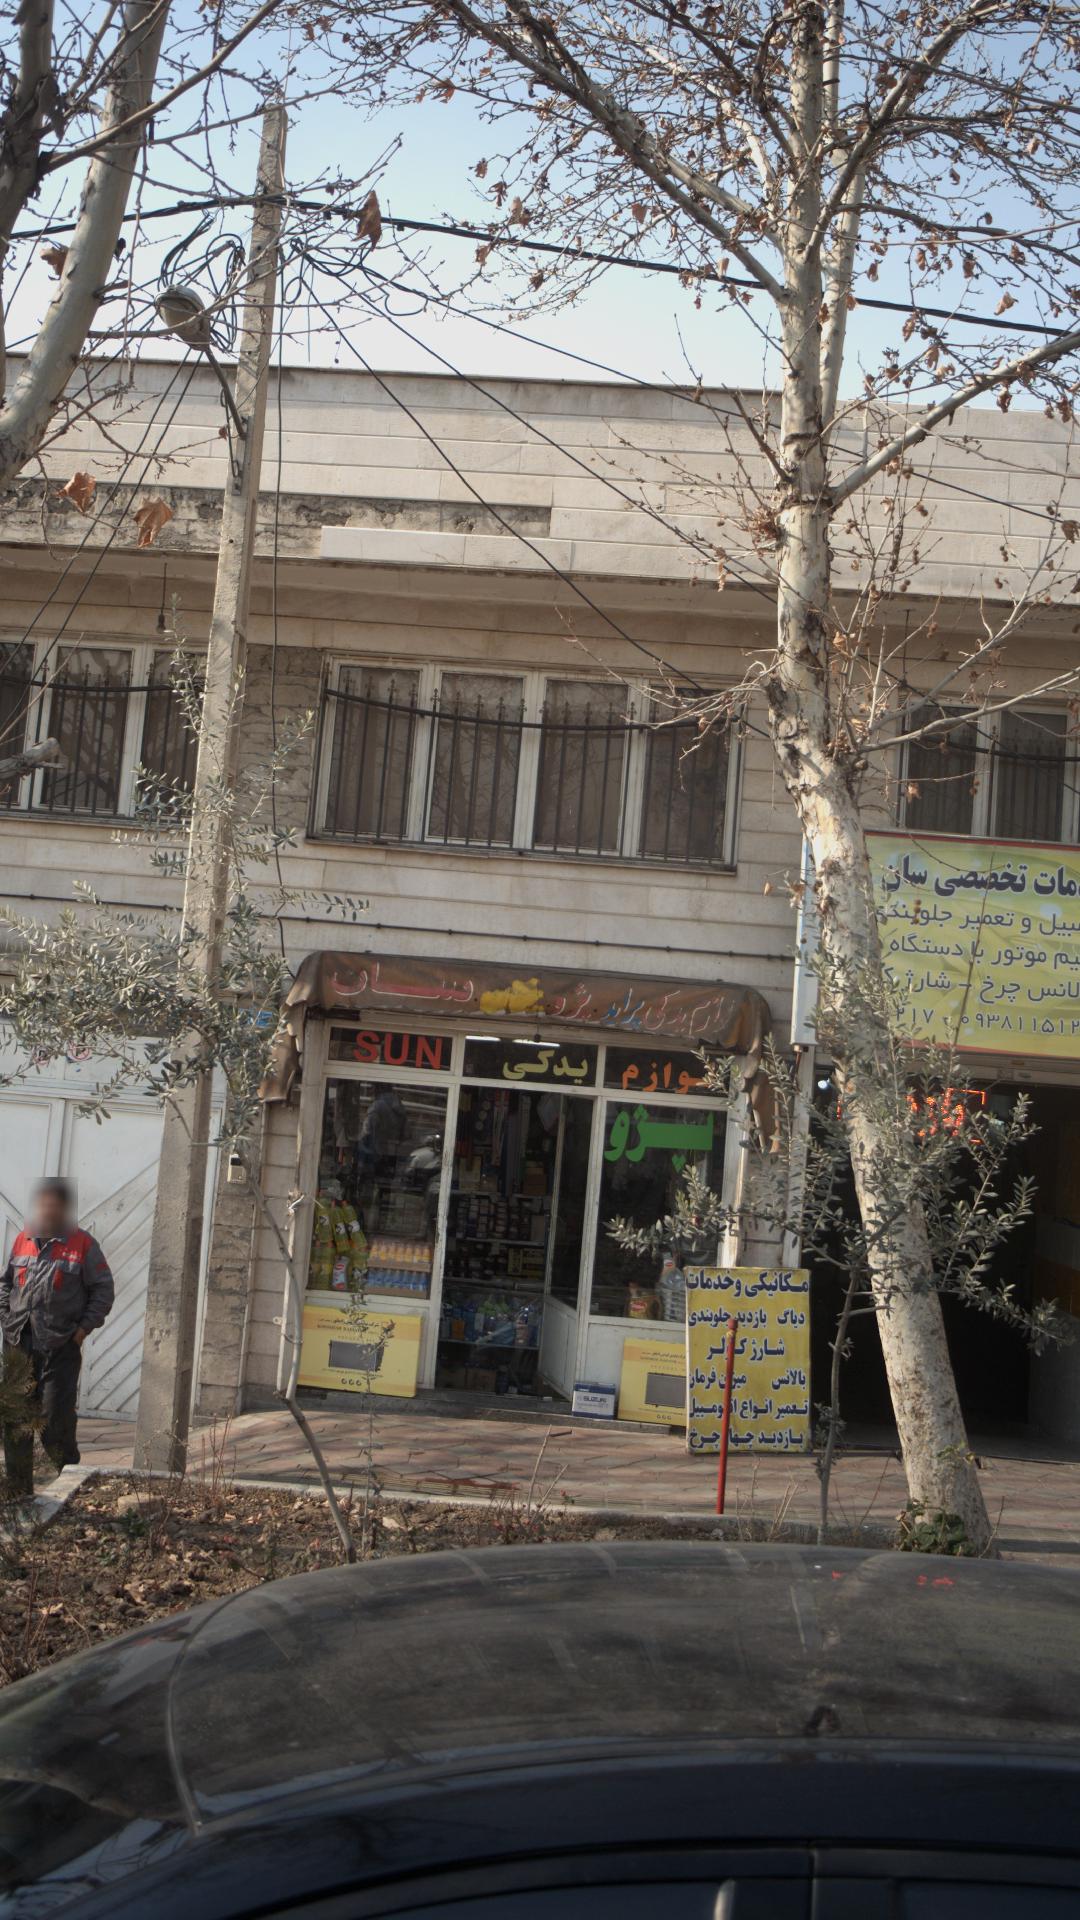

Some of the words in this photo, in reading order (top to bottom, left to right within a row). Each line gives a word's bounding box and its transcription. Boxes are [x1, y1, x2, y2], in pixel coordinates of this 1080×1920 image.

[881, 855, 927, 892] سان
[933, 862, 1028, 896] تخصصی
[1034, 866, 1080, 897] مات
[958, 912, 1015, 930] تعمیر
[1021, 917, 1031, 933] و
[889, 934, 964, 956] دستگاه
[971, 941, 984, 964] با
[991, 947, 1047, 968] موتور
[901, 969, 951, 993] شارژ
[980, 975, 1021, 1004] چرخ
[353, 1029, 443, 1070] SUN
[502, 1049, 589, 1085] یدکی
[621, 1061, 716, 1095] وازم
[603, 1104, 715, 1174] پژو
[744, 1271, 809, 1298] مکانیکی
[688, 1306, 732, 1328] جلوبندی
[734, 1307, 768, 1329] بازدید
[706, 1335, 748, 1360] کلر
[749, 1337, 785, 1361] شارژ
[771, 1368, 806, 1390] بالانس
[739, 1398, 773, 1419] انواع
[775, 1399, 809, 1420] تعمیر
[689, 1428, 721, 1450] چرخ
[728, 1427, 755, 1449] چها
[758, 1427, 804, 1449] بازدید
